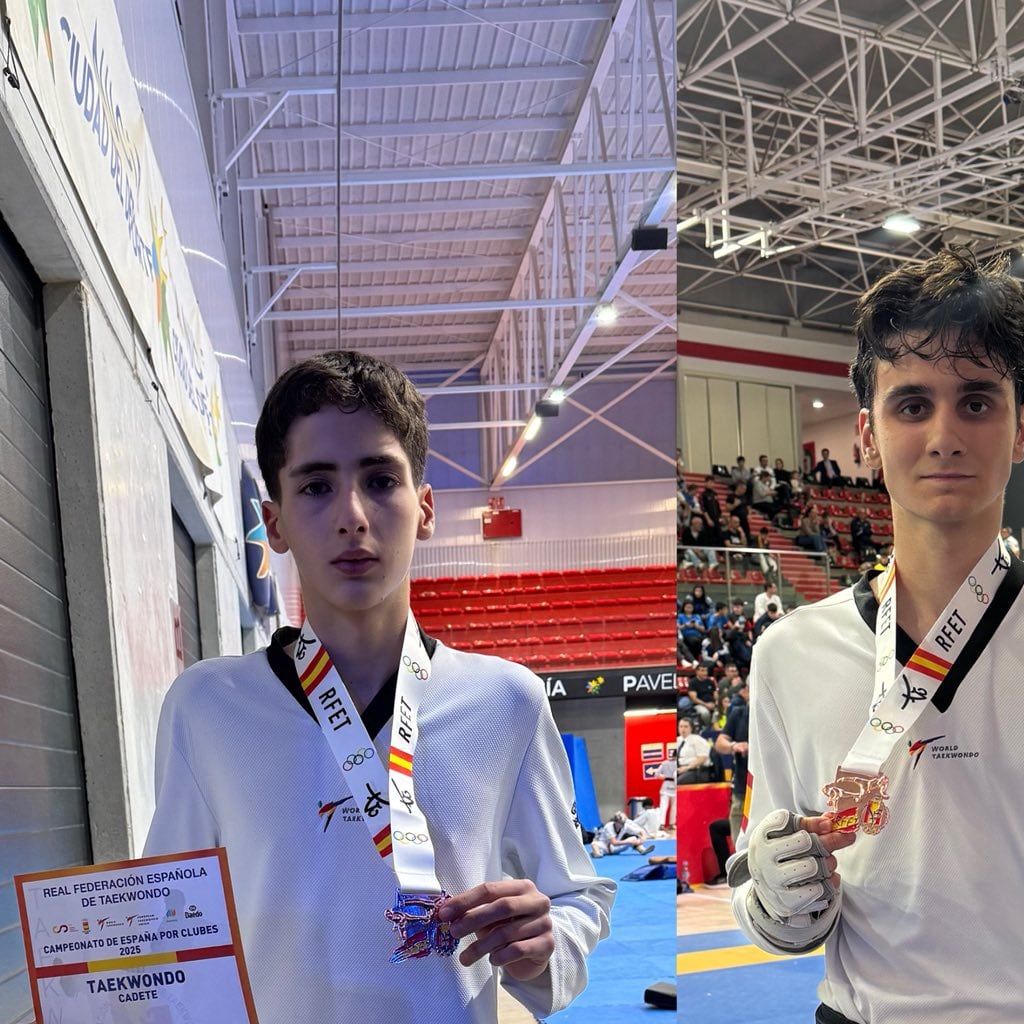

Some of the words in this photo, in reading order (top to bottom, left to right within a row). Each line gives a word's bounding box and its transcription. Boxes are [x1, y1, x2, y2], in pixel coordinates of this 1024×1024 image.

[934, 608, 967, 653] RFET
[318, 686, 352, 732] RFET
[932, 752, 980, 760] TAEKWONDO
[342, 807, 361, 815] WOR
[43, 886, 72, 899] REAL
[73, 873, 145, 895] FEDERACIÓN
[147, 866, 208, 885] ESPAÑOLA
[81, 897, 97, 908] DE
[100, 886, 171, 905] TAEKWONDO
[43, 939, 104, 955] CAMPEONATO
[106, 936, 119, 948] DE
[120, 930, 159, 946] ESPAÑA
[160, 930, 179, 941] POR
[181, 924, 219, 938] CLUBES
[119, 945, 142, 957] 2025
[86, 969, 186, 994] TAEKWONDO
[118, 989, 159, 1004] CADETE
